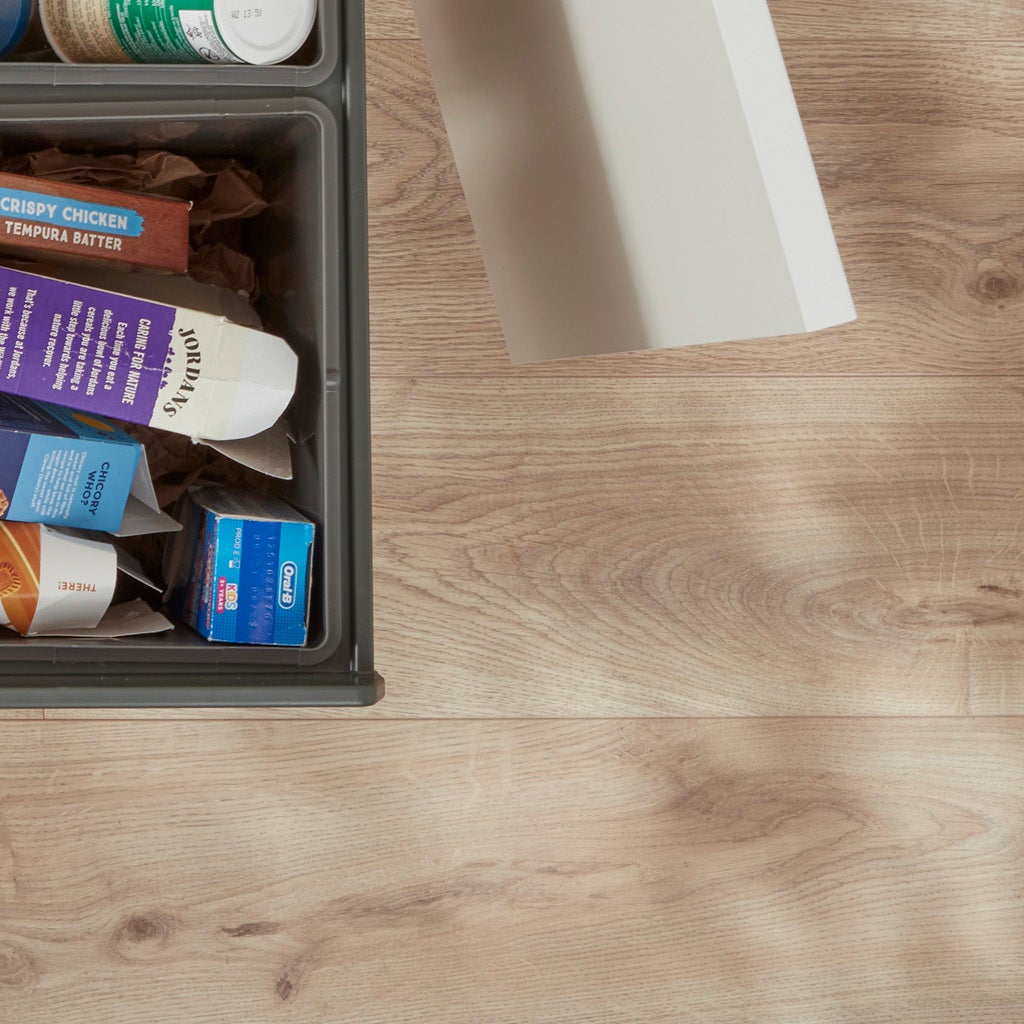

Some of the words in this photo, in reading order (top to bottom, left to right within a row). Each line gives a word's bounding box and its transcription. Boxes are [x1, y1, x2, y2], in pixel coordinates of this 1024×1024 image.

[0, 197, 57, 218] CRISPY
[62, 206, 127, 229] CHICKEN
[5, 221, 67, 242] TEMPURA
[73, 231, 121, 250] BATTER
[3, 297, 14, 315] work
[23, 289, 37, 309] That's
[70, 300, 82, 316] little
[0, 315, 11, 331] with
[16, 309, 32, 340] because
[49, 313, 61, 337] nature
[65, 316, 77, 332] step
[83, 306, 95, 332] cereals
[98, 309, 113, 340] delicious
[115, 321, 127, 339] Each
[80, 332, 91, 346] you
[134, 318, 151, 350] CARING
[42, 337, 56, 367] recover.
[60, 333, 75, 362] towards
[77, 346, 87, 360] are
[94, 340, 107, 358] bowl
[111, 339, 123, 356] time
[129, 350, 144, 369] FOR
[5, 349, 23, 379] Jordans,
[69, 361, 85, 384] taking
[108, 356, 118, 370] you
[163, 328, 200, 417] JORDANS
[51, 362, 69, 390] helping
[85, 367, 101, 396] Jordans
[104, 371, 115, 384] eat
[121, 370, 140, 405] NATURE
[80, 471, 97, 506] WHO?
[88, 461, 110, 516] CHICORY
[234, 528, 242, 549] PROD
[58, 581, 96, 592] THERE!
[226, 583, 238, 610] KIDS
[282, 565, 295, 604] Oral-B
